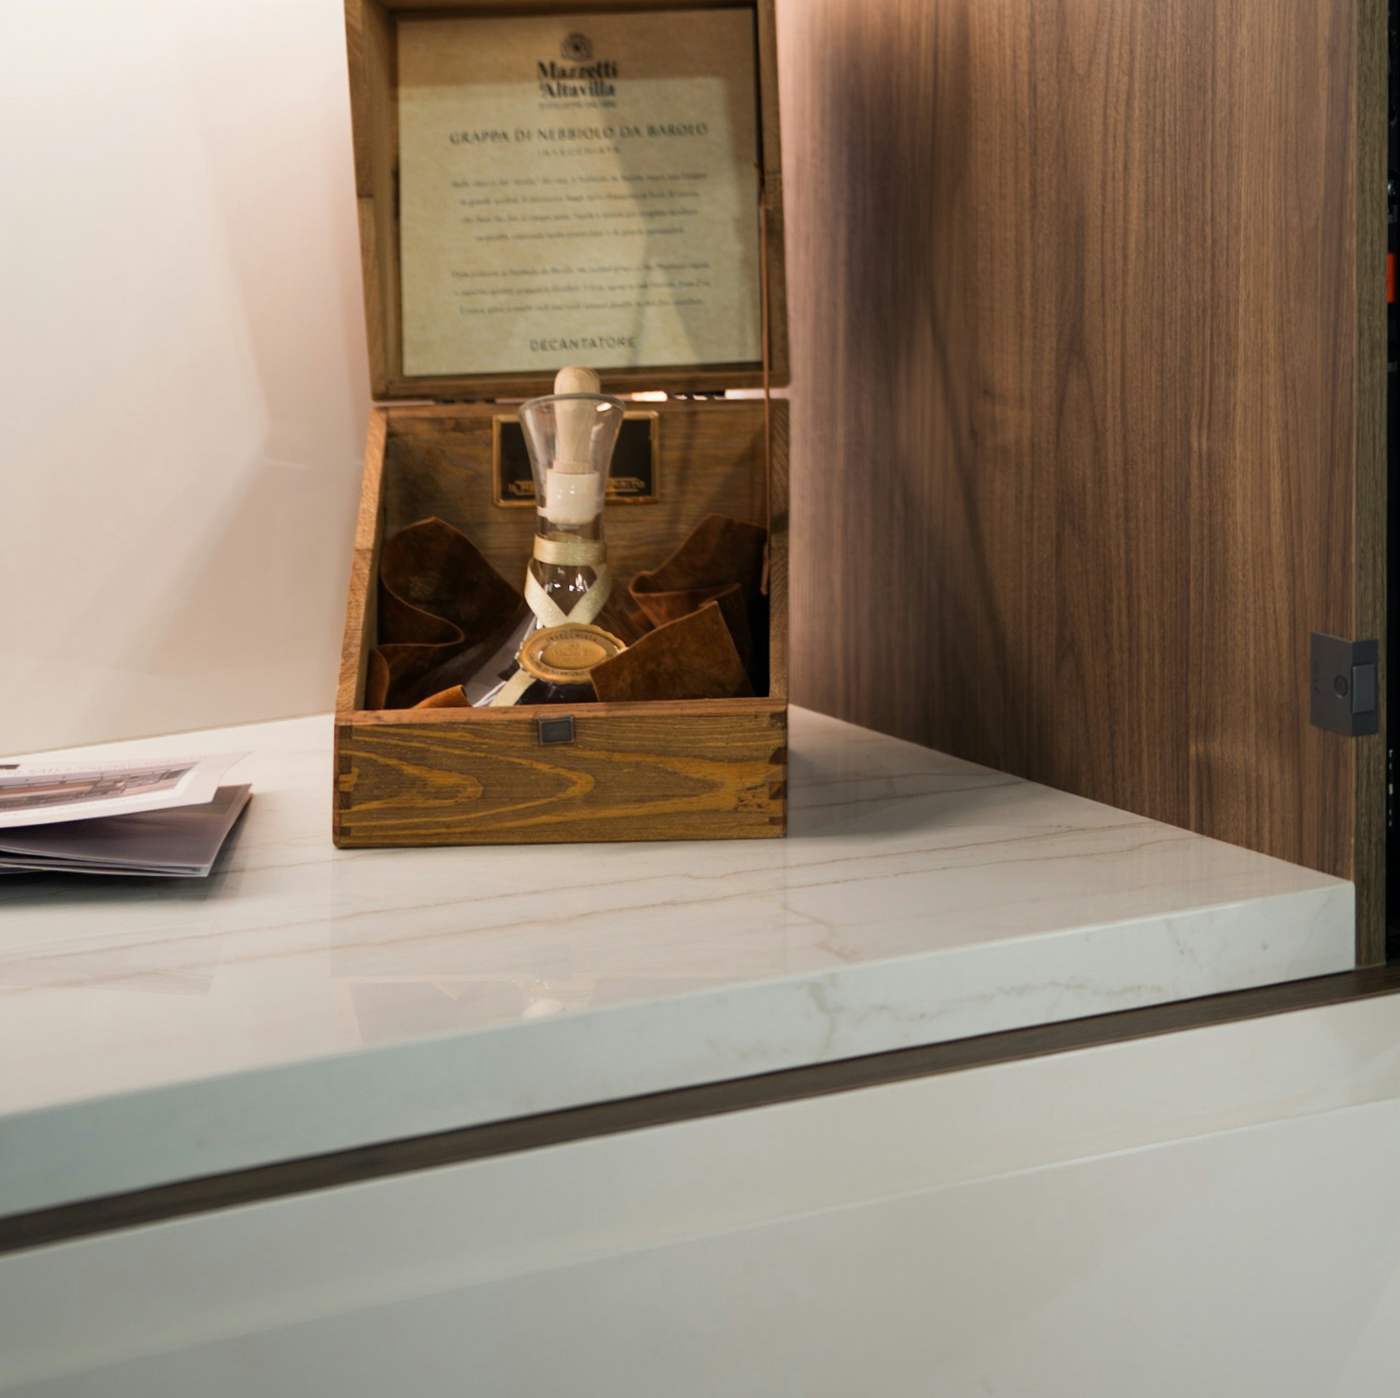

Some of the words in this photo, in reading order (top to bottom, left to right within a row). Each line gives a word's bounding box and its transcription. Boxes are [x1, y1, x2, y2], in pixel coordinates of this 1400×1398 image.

[449, 128, 509, 145] GRAPPA
[514, 127, 532, 141] DI
[537, 124, 616, 141] NEBBIOLO
[619, 124, 641, 138] DA
[646, 122, 708, 137] BAROLO
[530, 336, 636, 352] DECANTATORE
